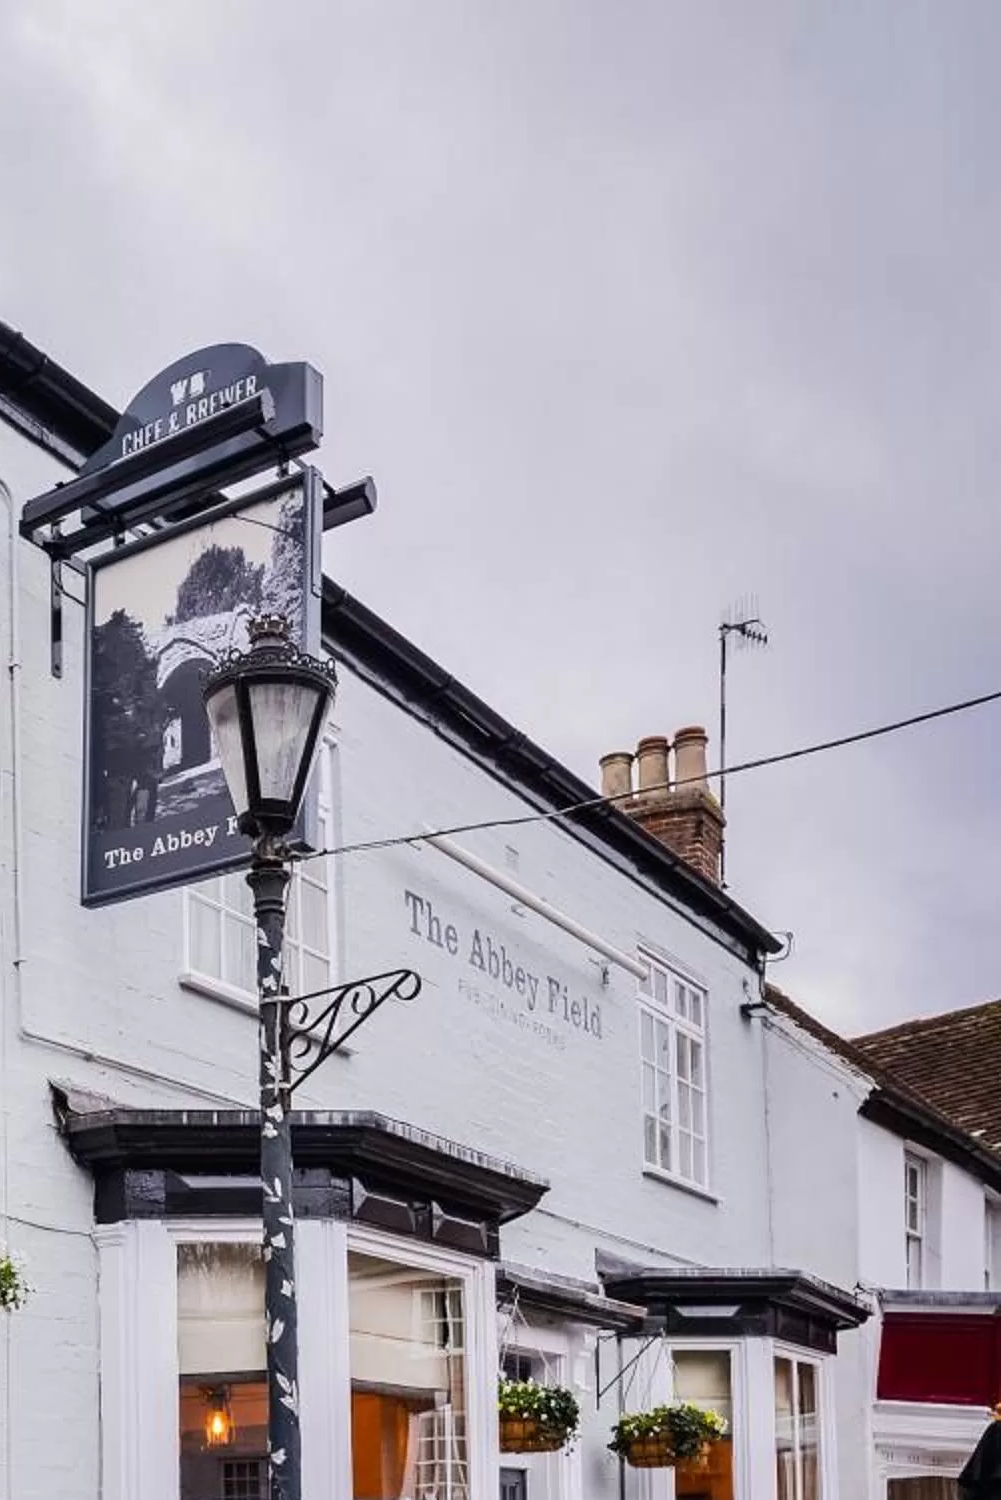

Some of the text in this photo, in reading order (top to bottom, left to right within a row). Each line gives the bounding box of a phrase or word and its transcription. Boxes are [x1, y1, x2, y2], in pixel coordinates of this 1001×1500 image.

[122, 376, 257, 457] CHEF & BREWER
[104, 847, 144, 869] The
[150, 825, 219, 857] Abbey
[404, 889, 459, 956] The
[469, 929, 539, 1011] Abbey
[547, 975, 602, 1039] Field
